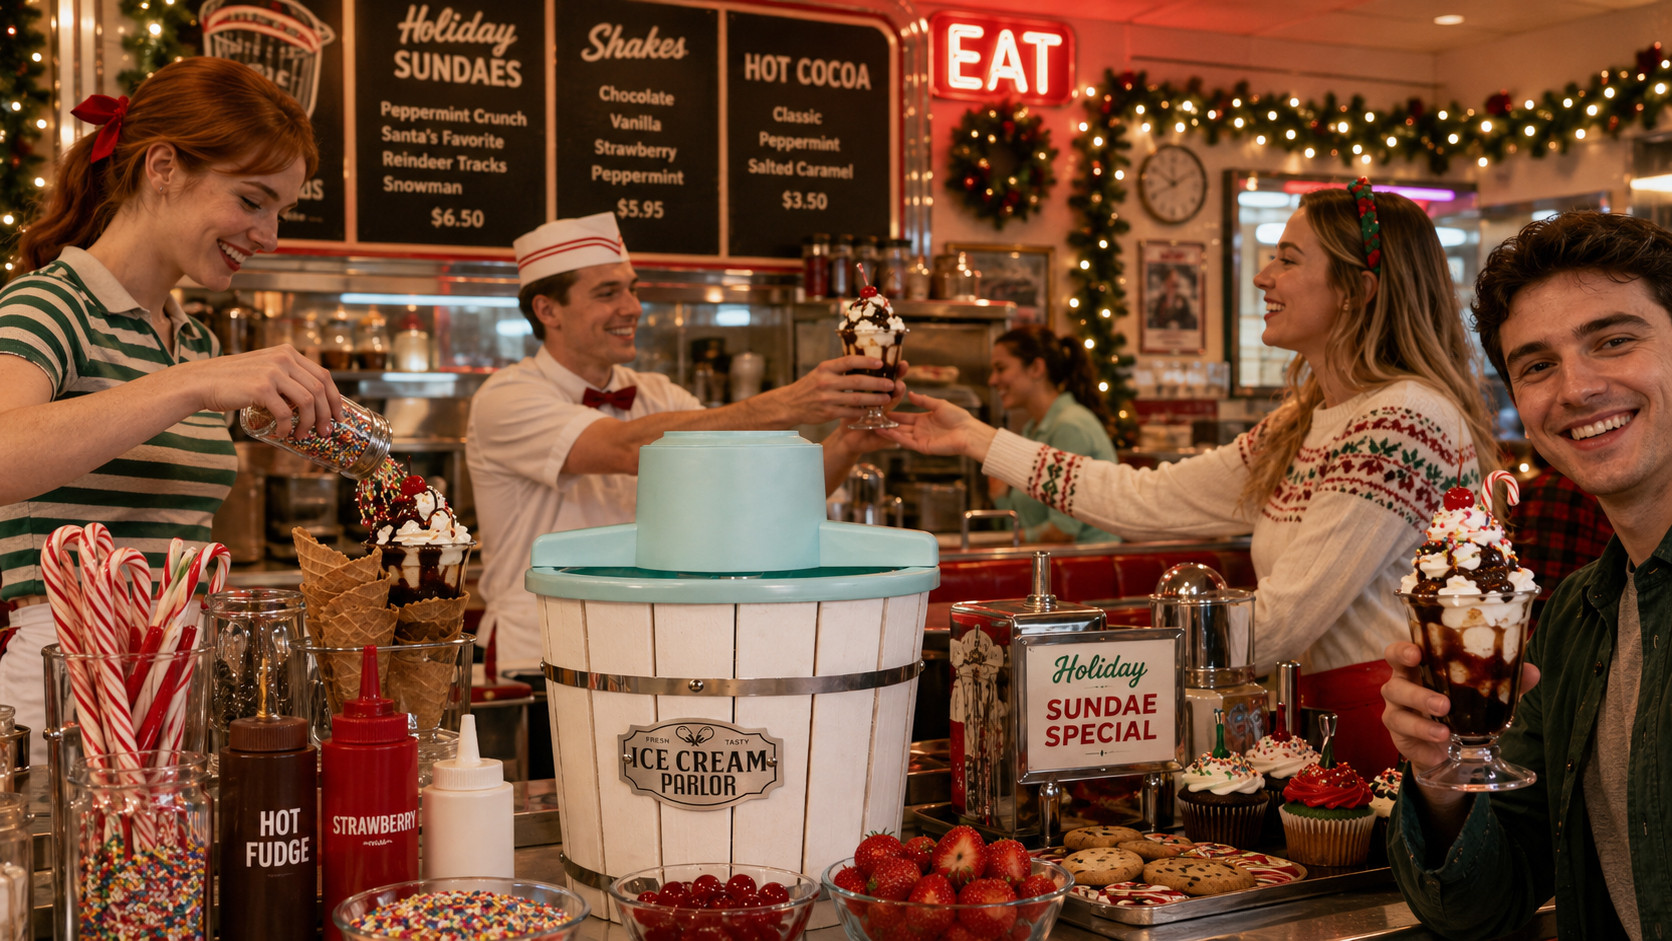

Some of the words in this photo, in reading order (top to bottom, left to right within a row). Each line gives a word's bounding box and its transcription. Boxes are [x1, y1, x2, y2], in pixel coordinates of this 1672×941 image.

[397, 4, 518, 57] Holiday
[580, 22, 689, 62] Shakes
[393, 50, 523, 88] SUNDAES
[744, 52, 791, 83] HOT
[796, 57, 872, 90] COCOA
[948, 23, 1062, 95] EAT
[599, 85, 675, 106] Chocolate
[380, 100, 470, 122] Peppermint
[474, 108, 527, 127] Crunch
[610, 113, 662, 132] Vanilla
[772, 106, 823, 125] Classic
[381, 125, 438, 145] Santa's
[442, 130, 504, 149] Favorite
[759, 131, 840, 152] Peppermint
[382, 150, 453, 170] Reindeer
[457, 155, 507, 173] Tracks
[594, 138, 677, 163] Strawberry
[591, 164, 684, 186] Peppermint
[748, 158, 793, 176] Salted
[796, 160, 854, 179] Caramel
[383, 175, 463, 195] Snowman
[617, 197, 664, 219] $5.95
[782, 190, 828, 211] $3.50
[430, 206, 485, 228] $6.50
[1052, 654, 1148, 688] Holiday
[1046, 693, 1157, 720] SUNDAE
[725, 738, 750, 746] TASTY
[1045, 720, 1157, 747] SPECIAL
[631, 746, 669, 770] ICE
[676, 749, 767, 773] CREAM
[661, 773, 736, 796] PARLOR
[260, 807, 301, 837] HOT
[332, 810, 416, 836] STRAWBERRY
[246, 836, 310, 868] FUDGE
